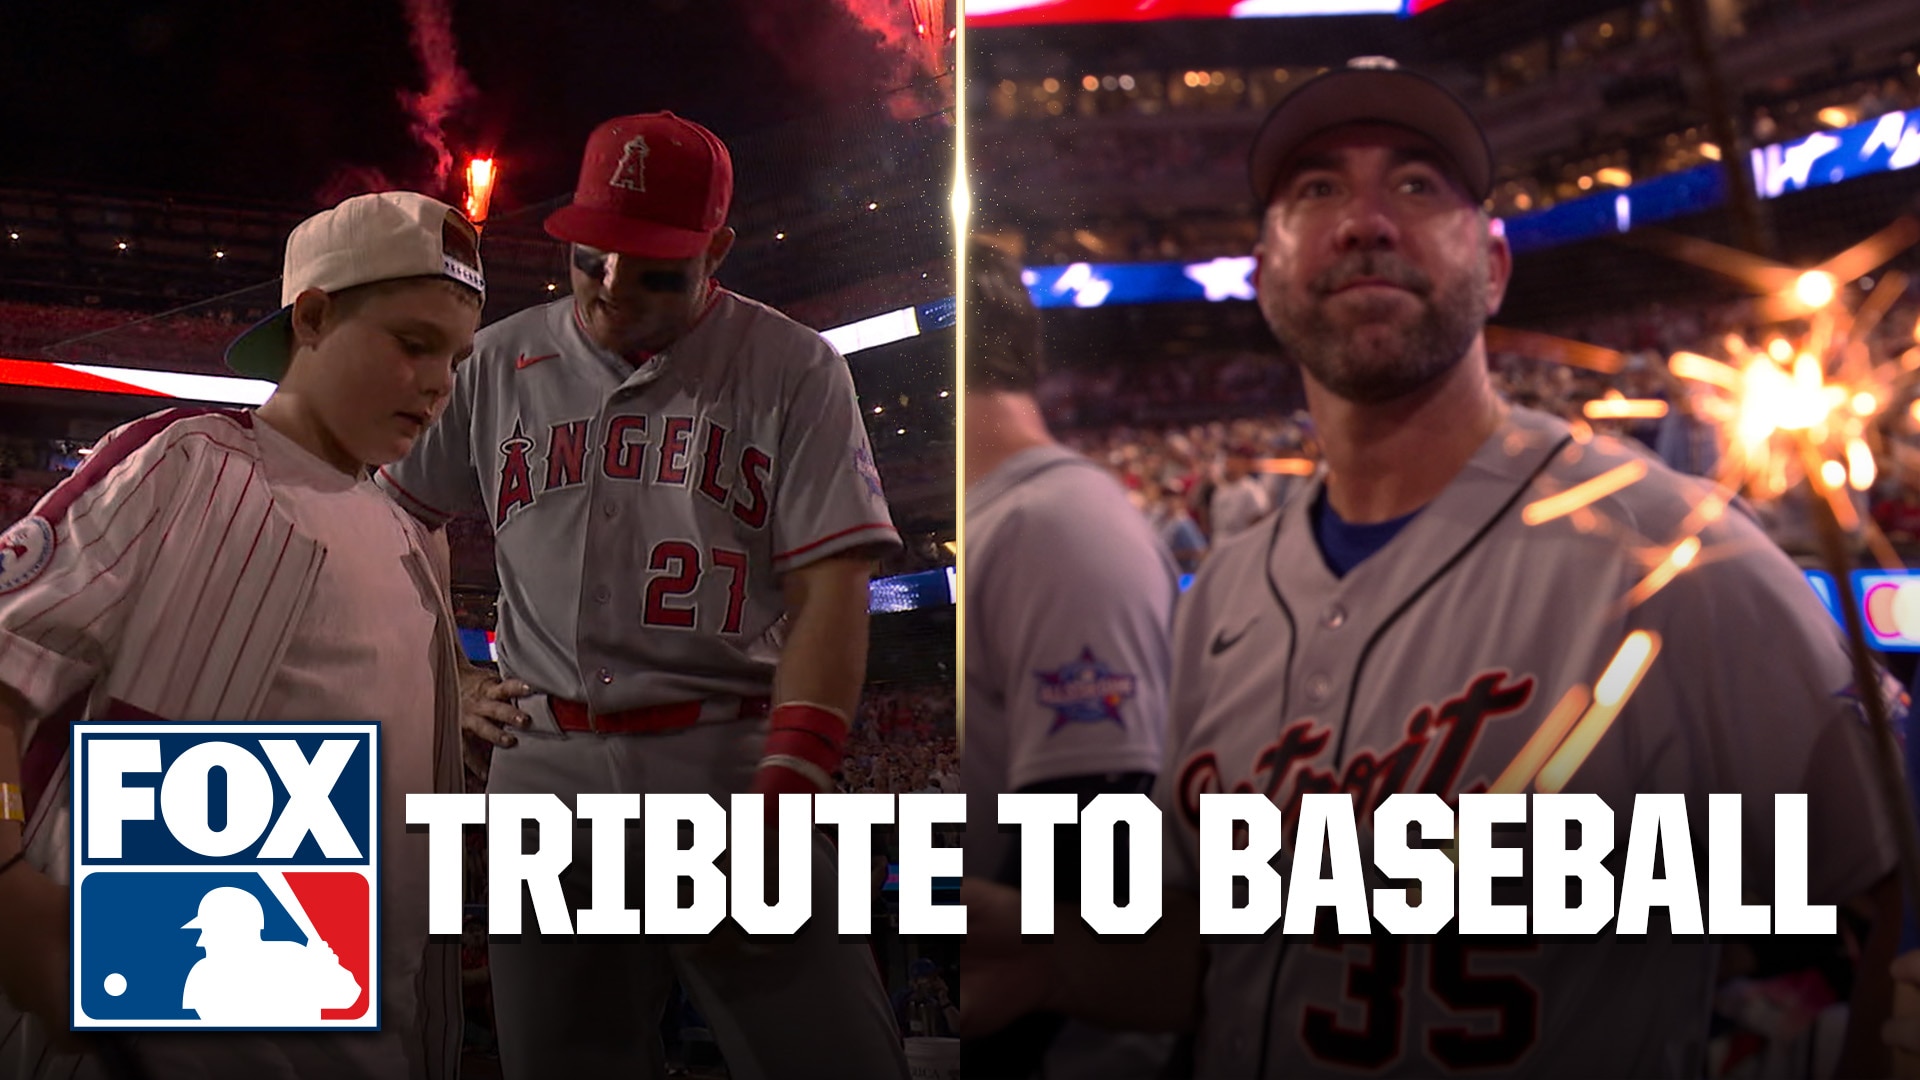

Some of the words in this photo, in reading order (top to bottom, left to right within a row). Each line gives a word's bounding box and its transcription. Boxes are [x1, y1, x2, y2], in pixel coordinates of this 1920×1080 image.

[495, 414, 773, 535] ANGELS
[641, 538, 748, 635] 27
[1177, 671, 1537, 838] Dtroit
[1300, 912, 1542, 1073] 35
